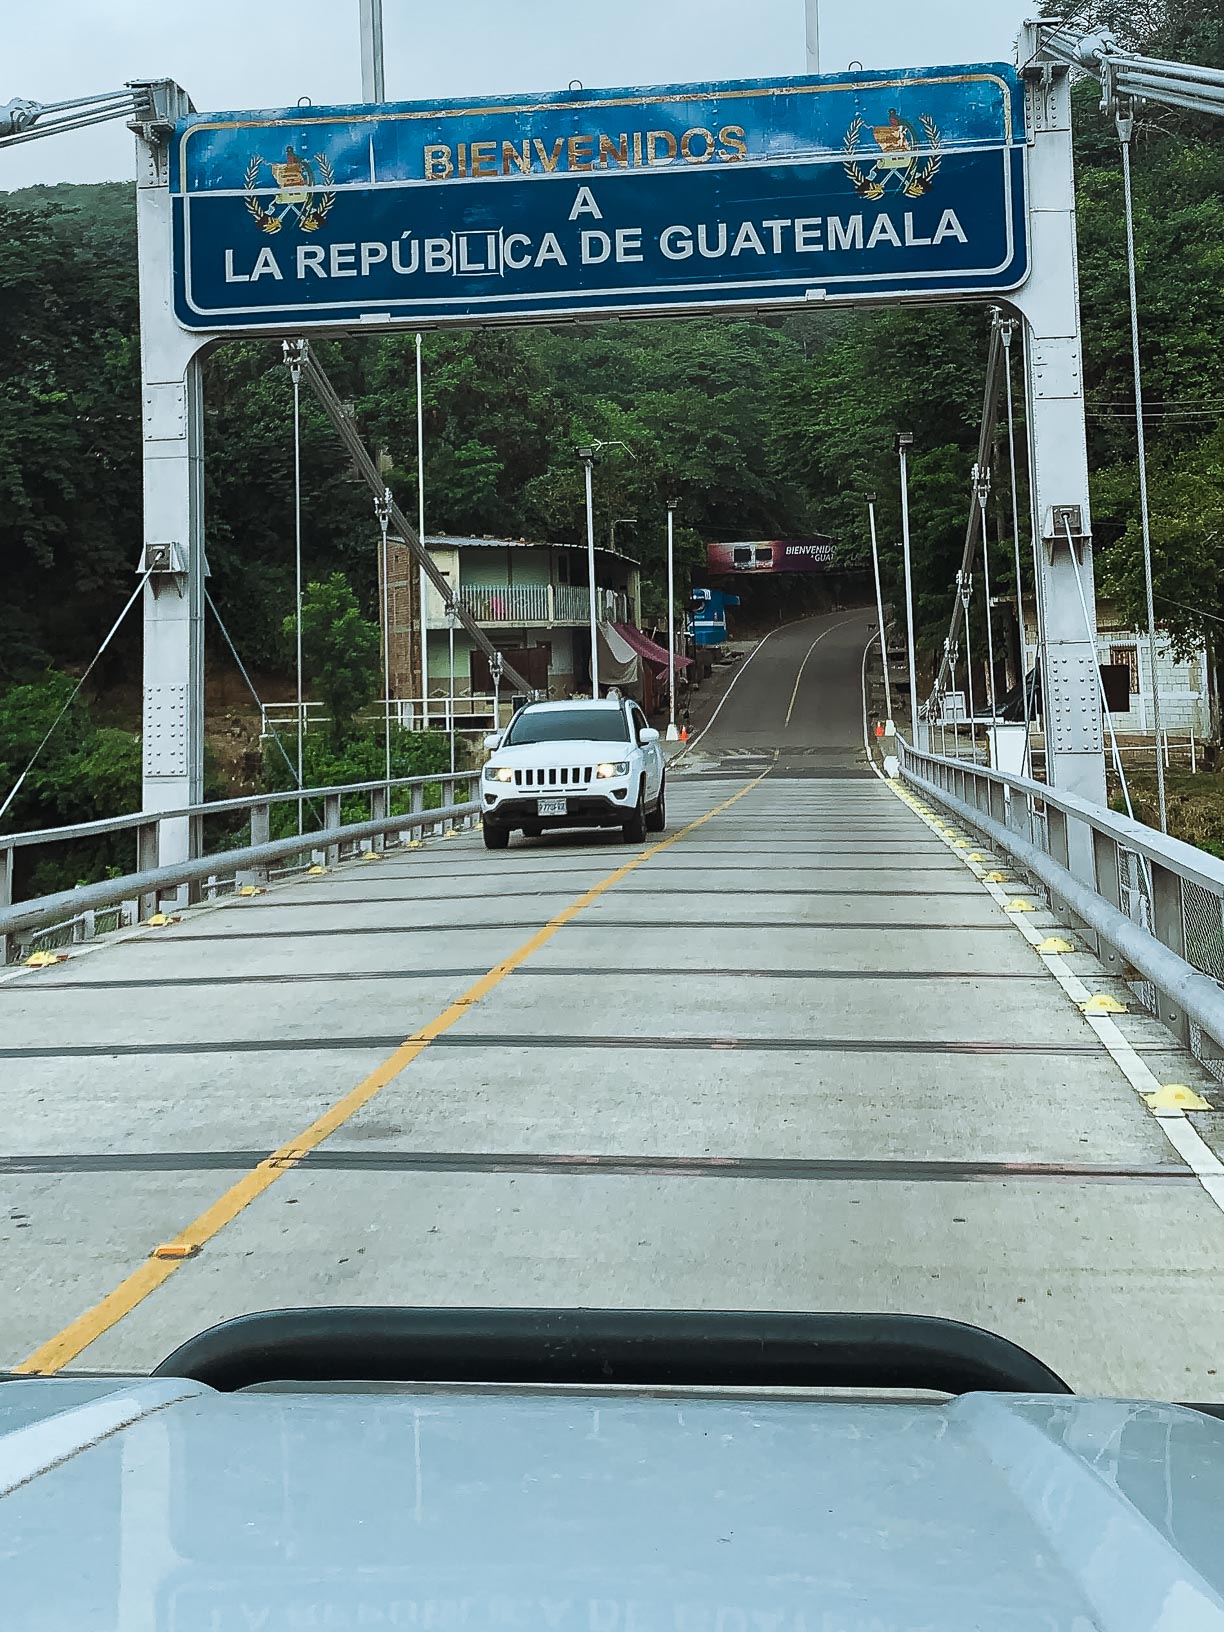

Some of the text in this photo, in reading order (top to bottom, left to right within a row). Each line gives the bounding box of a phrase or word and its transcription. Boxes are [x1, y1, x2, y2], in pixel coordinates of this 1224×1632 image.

[423, 125, 746, 181] BIENVENIDOS
[568, 186, 603, 221] A
[224, 208, 968, 283] LA REPÚBLICA DE GUATEMALA
[786, 545, 838, 555] BIENVENIDO
